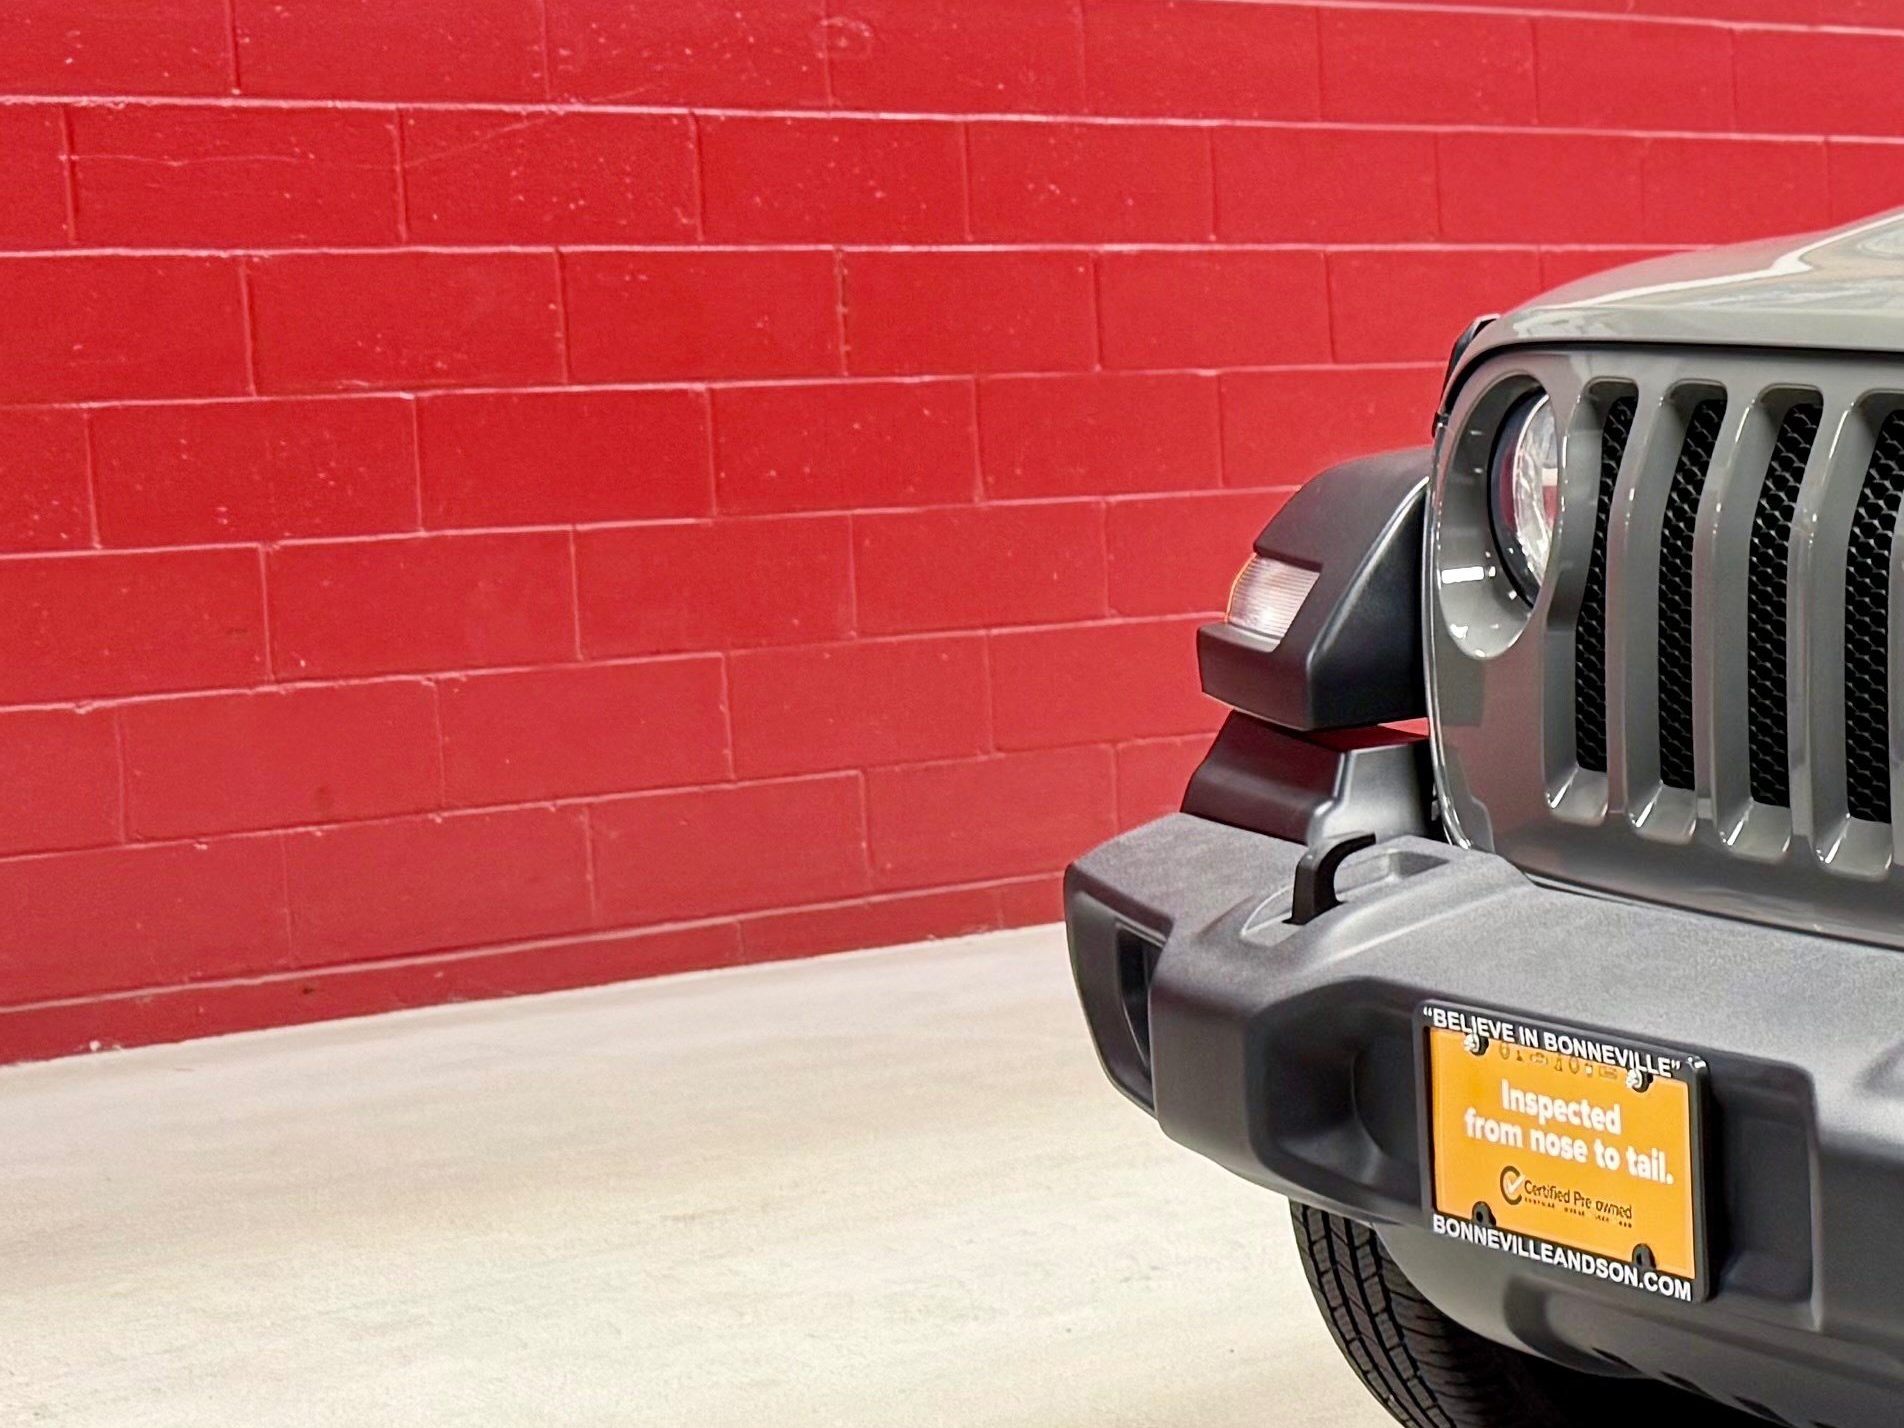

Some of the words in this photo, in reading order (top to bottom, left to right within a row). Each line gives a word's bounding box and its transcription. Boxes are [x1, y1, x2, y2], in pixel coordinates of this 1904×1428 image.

[1520, 1026, 1538, 1048] IN
[1501, 1078, 1622, 1135] Inspected
[1464, 1107, 1523, 1148] from
[1530, 1127, 1588, 1163] nose
[1594, 1138, 1620, 1170] to
[1626, 1145, 1674, 1185] tail.
[1433, 1214, 1692, 1301] BONNEVILLEANDSON.COM
